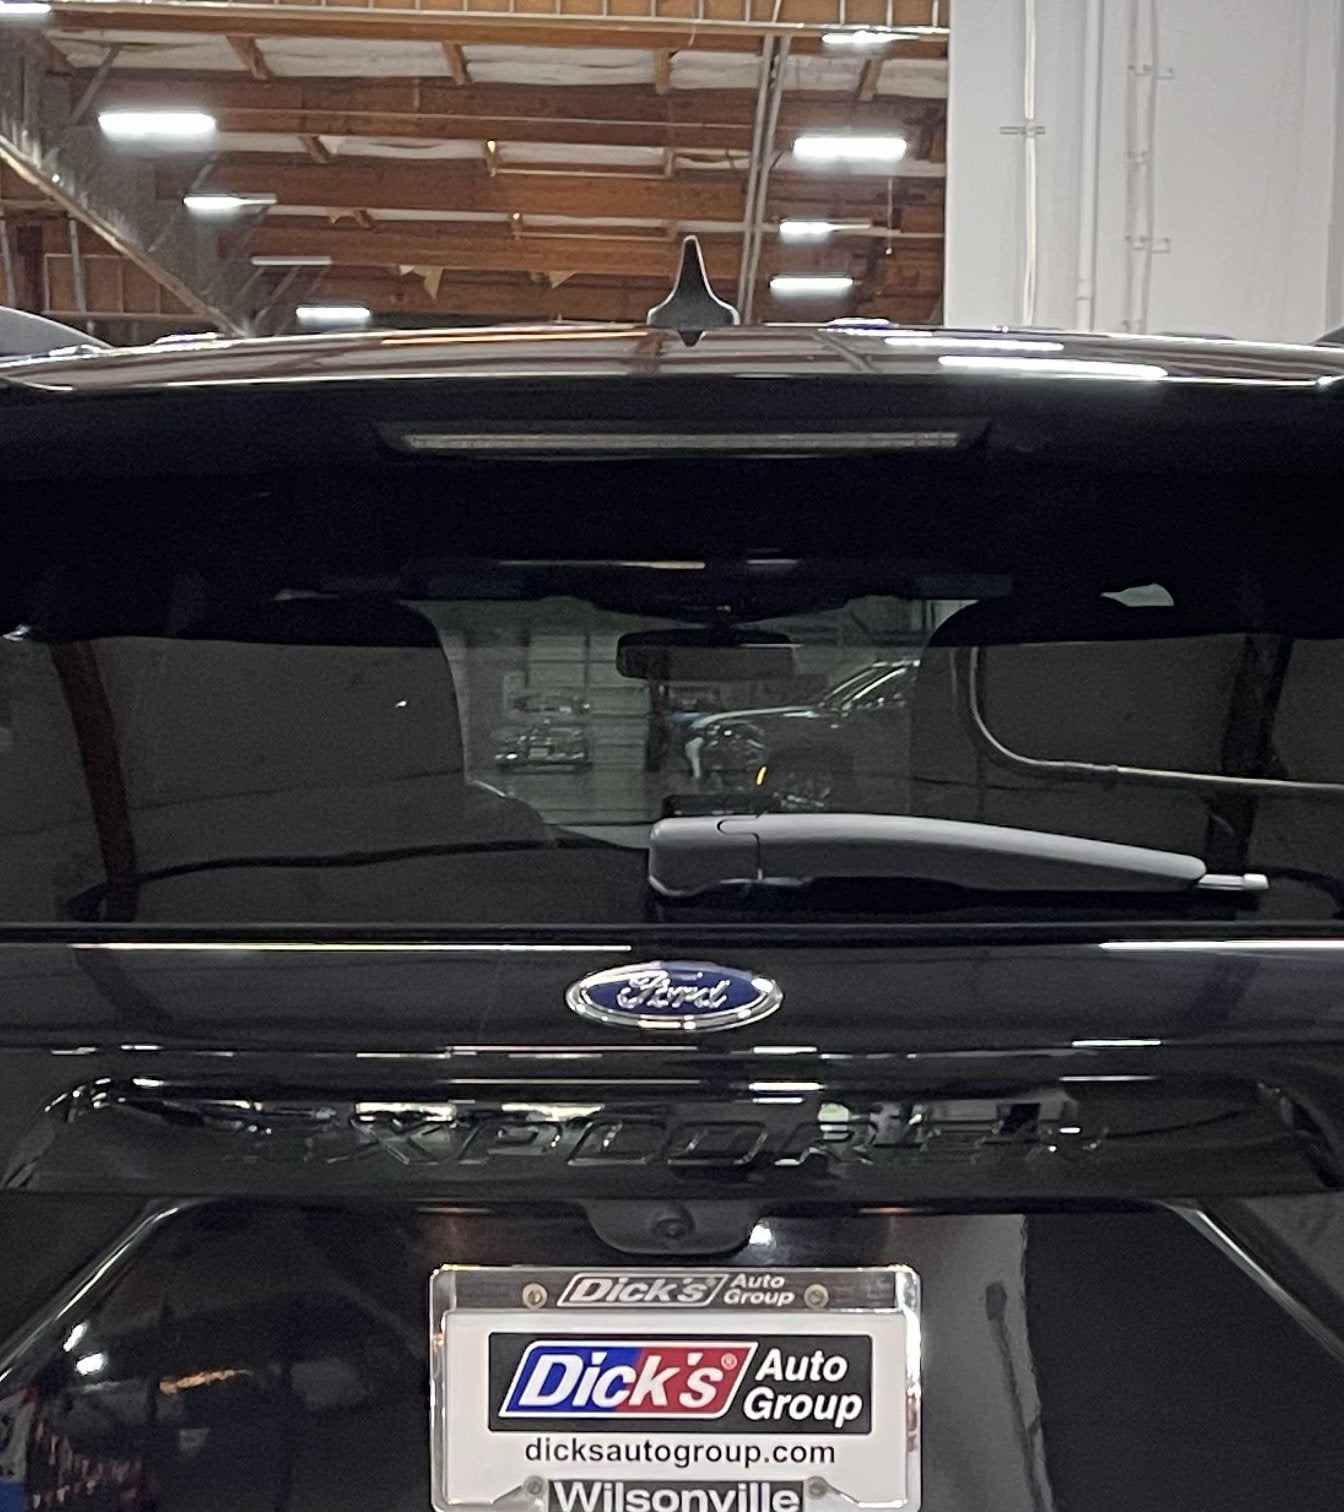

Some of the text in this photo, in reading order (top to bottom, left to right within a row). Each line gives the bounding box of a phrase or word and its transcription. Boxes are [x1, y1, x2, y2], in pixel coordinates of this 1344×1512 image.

[616, 972, 731, 1008] Ford
[723, 1288, 796, 1307] Group
[729, 1273, 786, 1289] Auto
[754, 1348, 849, 1383] Auto
[742, 1387, 863, 1428] Group
[524, 1437, 836, 1468] dicksautogroup.com
